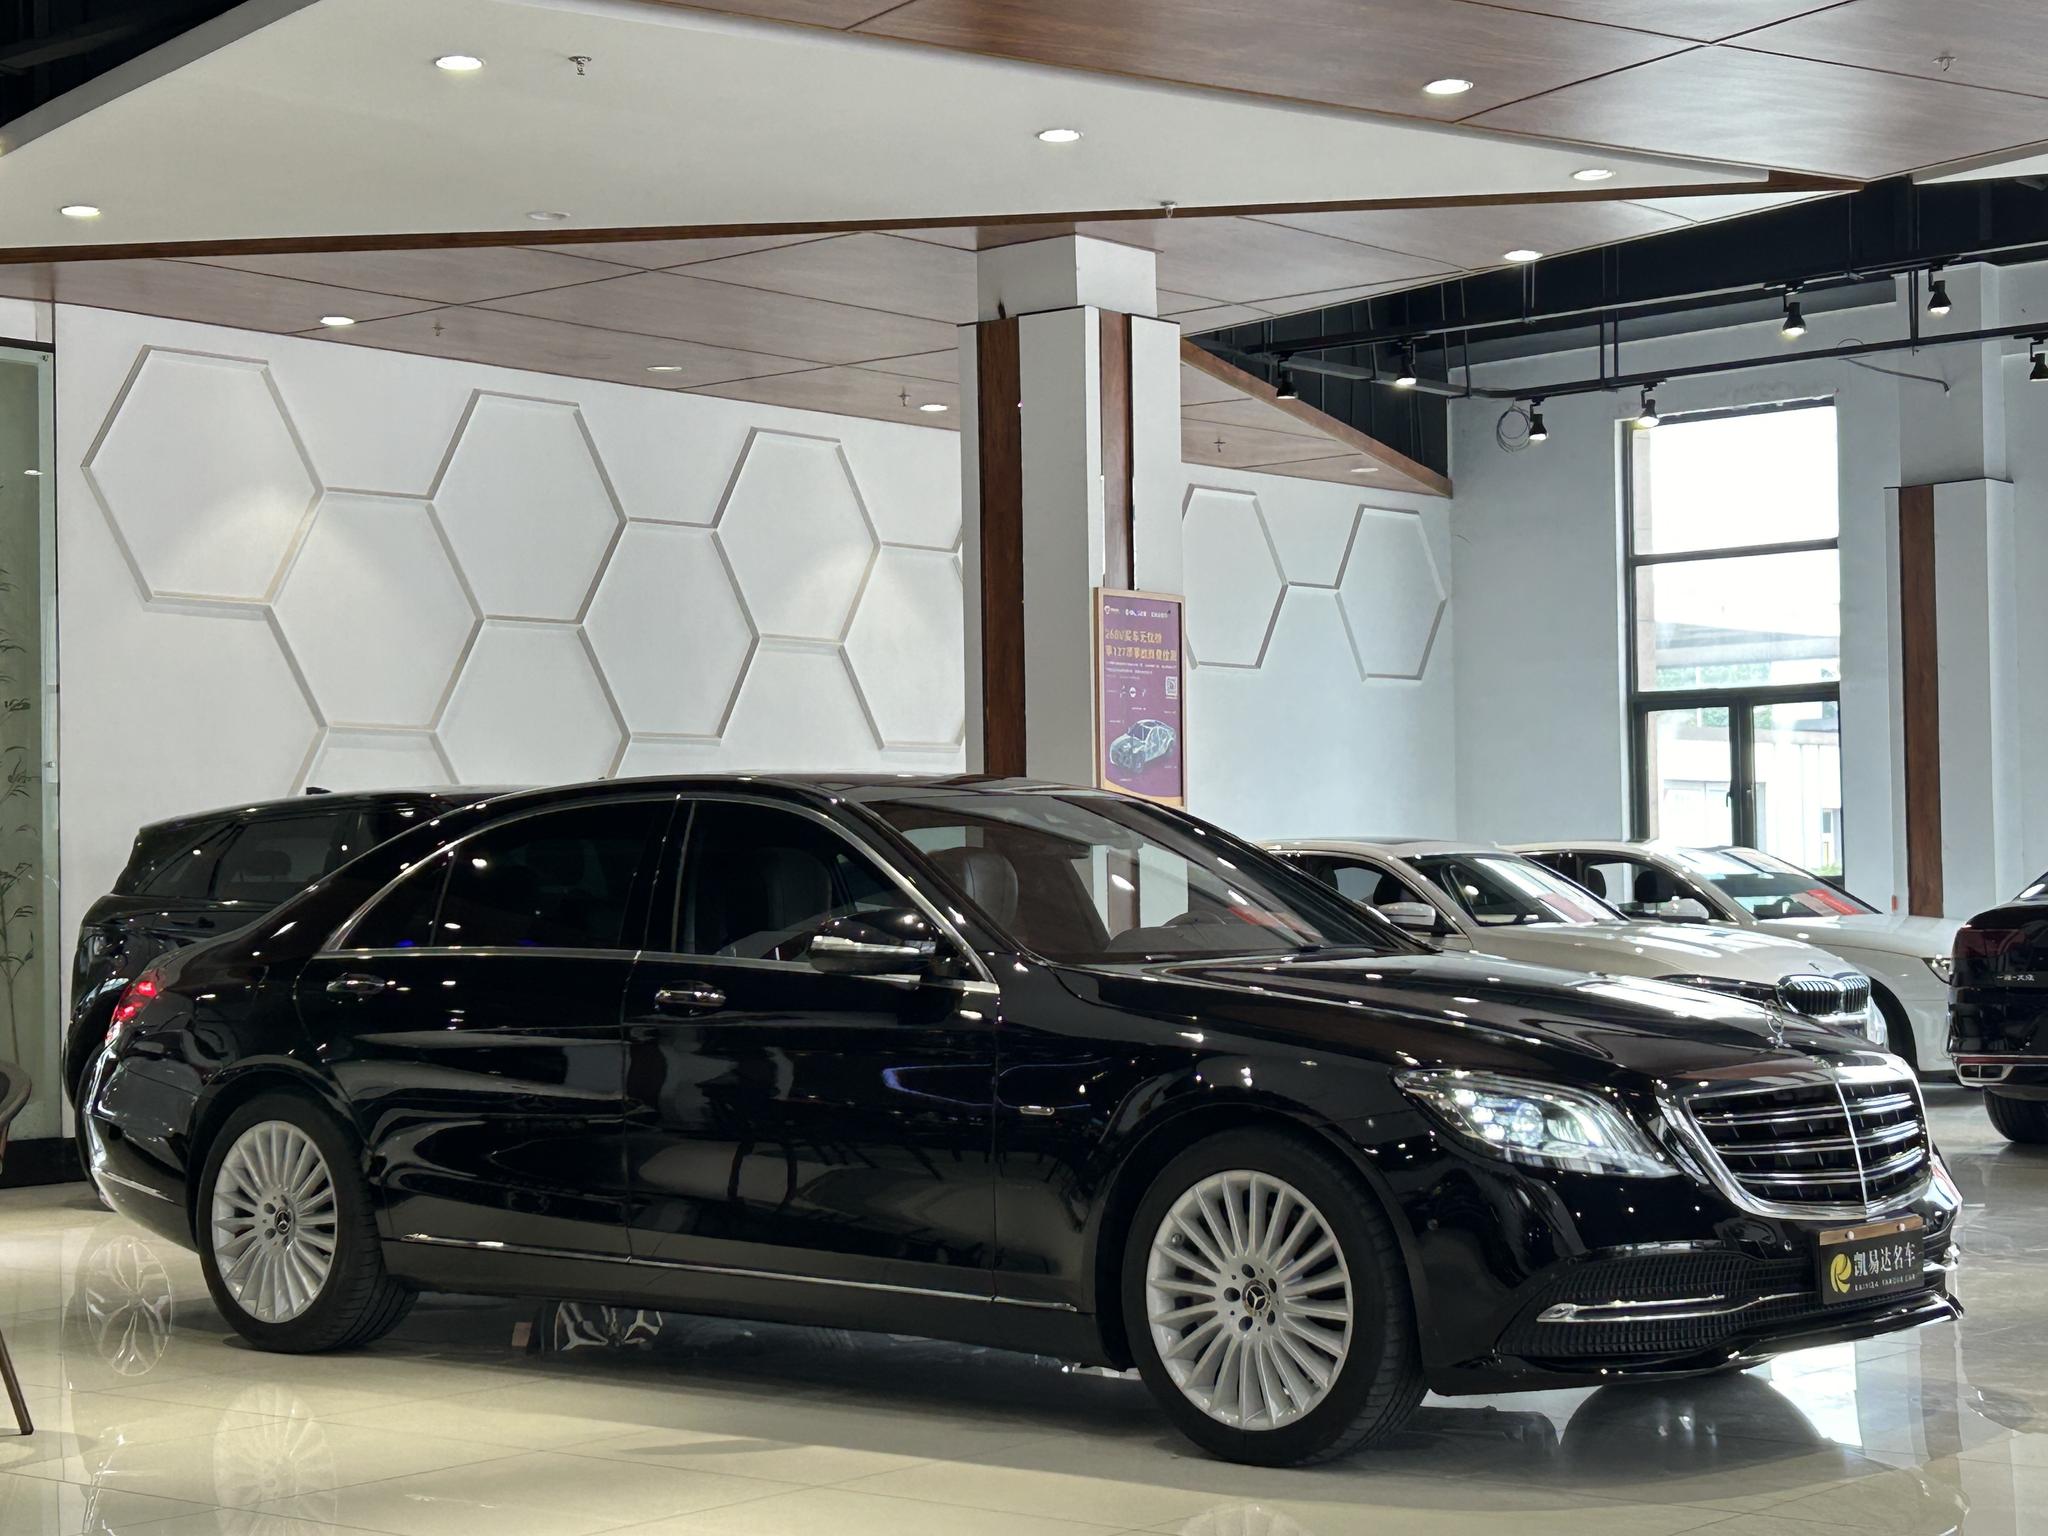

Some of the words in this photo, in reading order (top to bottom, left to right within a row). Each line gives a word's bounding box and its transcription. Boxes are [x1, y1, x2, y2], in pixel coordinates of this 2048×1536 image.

[1854, 1241, 1915, 1276] 凯易达名车
